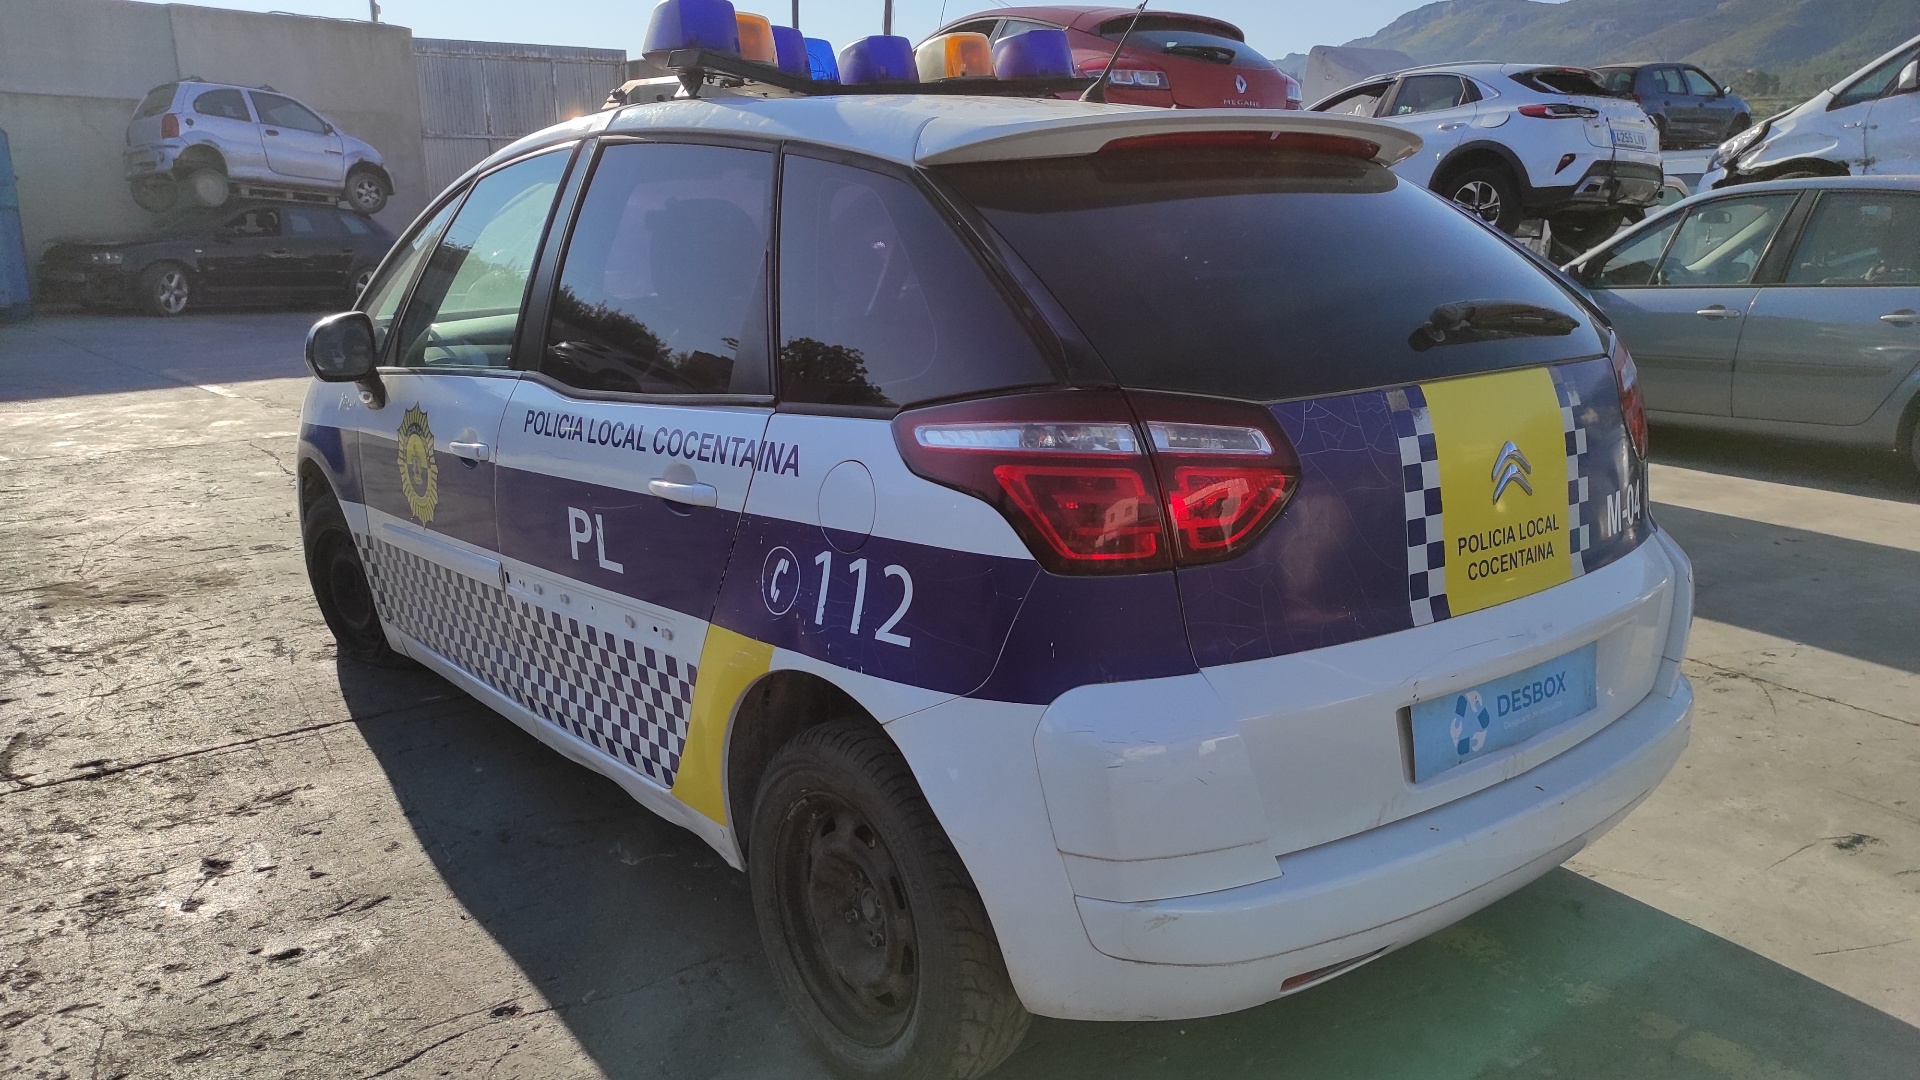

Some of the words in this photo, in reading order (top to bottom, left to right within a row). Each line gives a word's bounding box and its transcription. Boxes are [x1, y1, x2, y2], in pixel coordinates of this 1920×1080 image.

[1223, 98, 1261, 108] MEGANE
[523, 409, 583, 442] POLICIA
[587, 418, 647, 453] LOCAL
[652, 426, 800, 478] COCENTAINA
[1457, 525, 1517, 557] POLICIA
[1519, 513, 1560, 541] LOCAL
[1607, 478, 1641, 538] M-04
[567, 506, 624, 575] PL
[1467, 541, 1555, 582] COCENTAINA
[814, 550, 914, 648] 112
[1497, 670, 1567, 718] DESBOX
